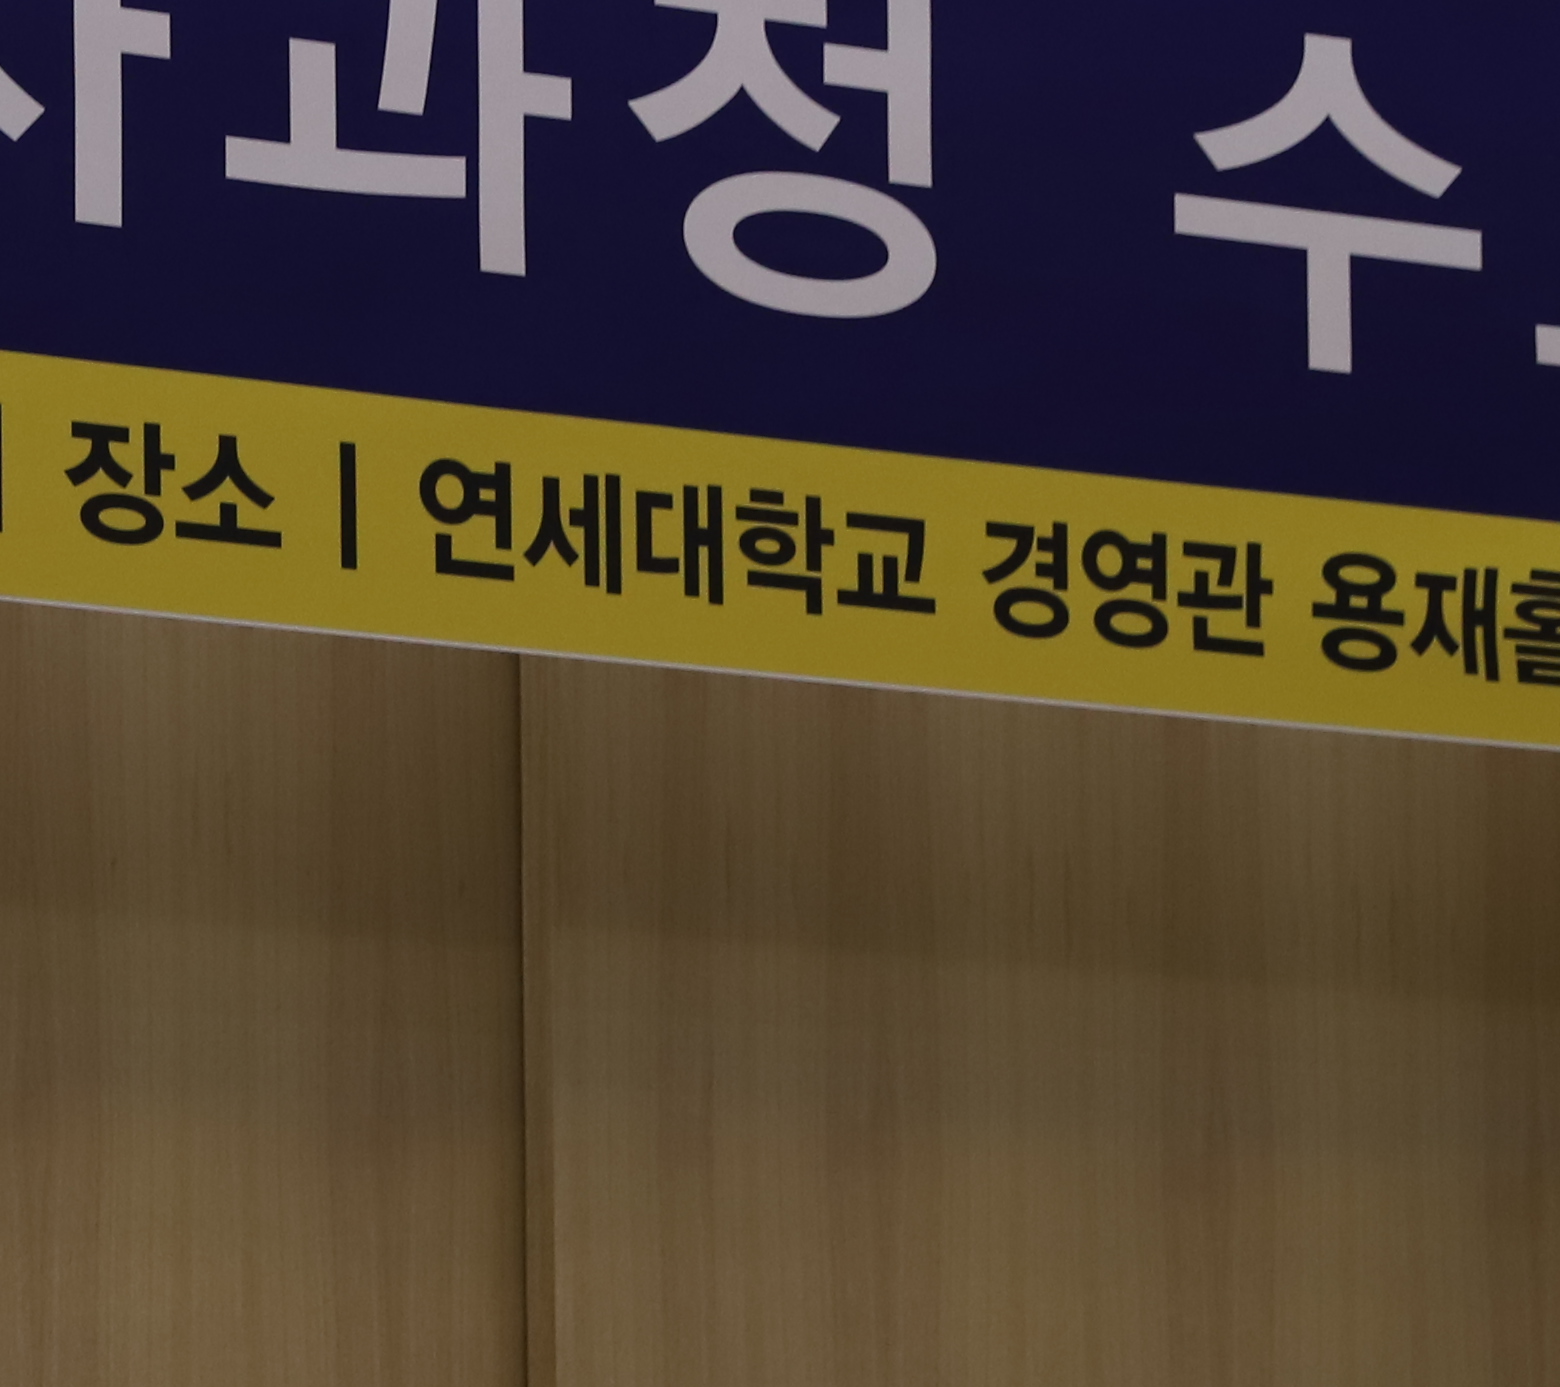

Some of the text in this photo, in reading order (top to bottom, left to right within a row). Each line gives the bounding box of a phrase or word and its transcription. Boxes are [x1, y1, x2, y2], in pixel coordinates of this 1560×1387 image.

[64, 421, 282, 549] 장소
[419, 458, 936, 616] 연세대학교
[982, 521, 1274, 657] 경영관
